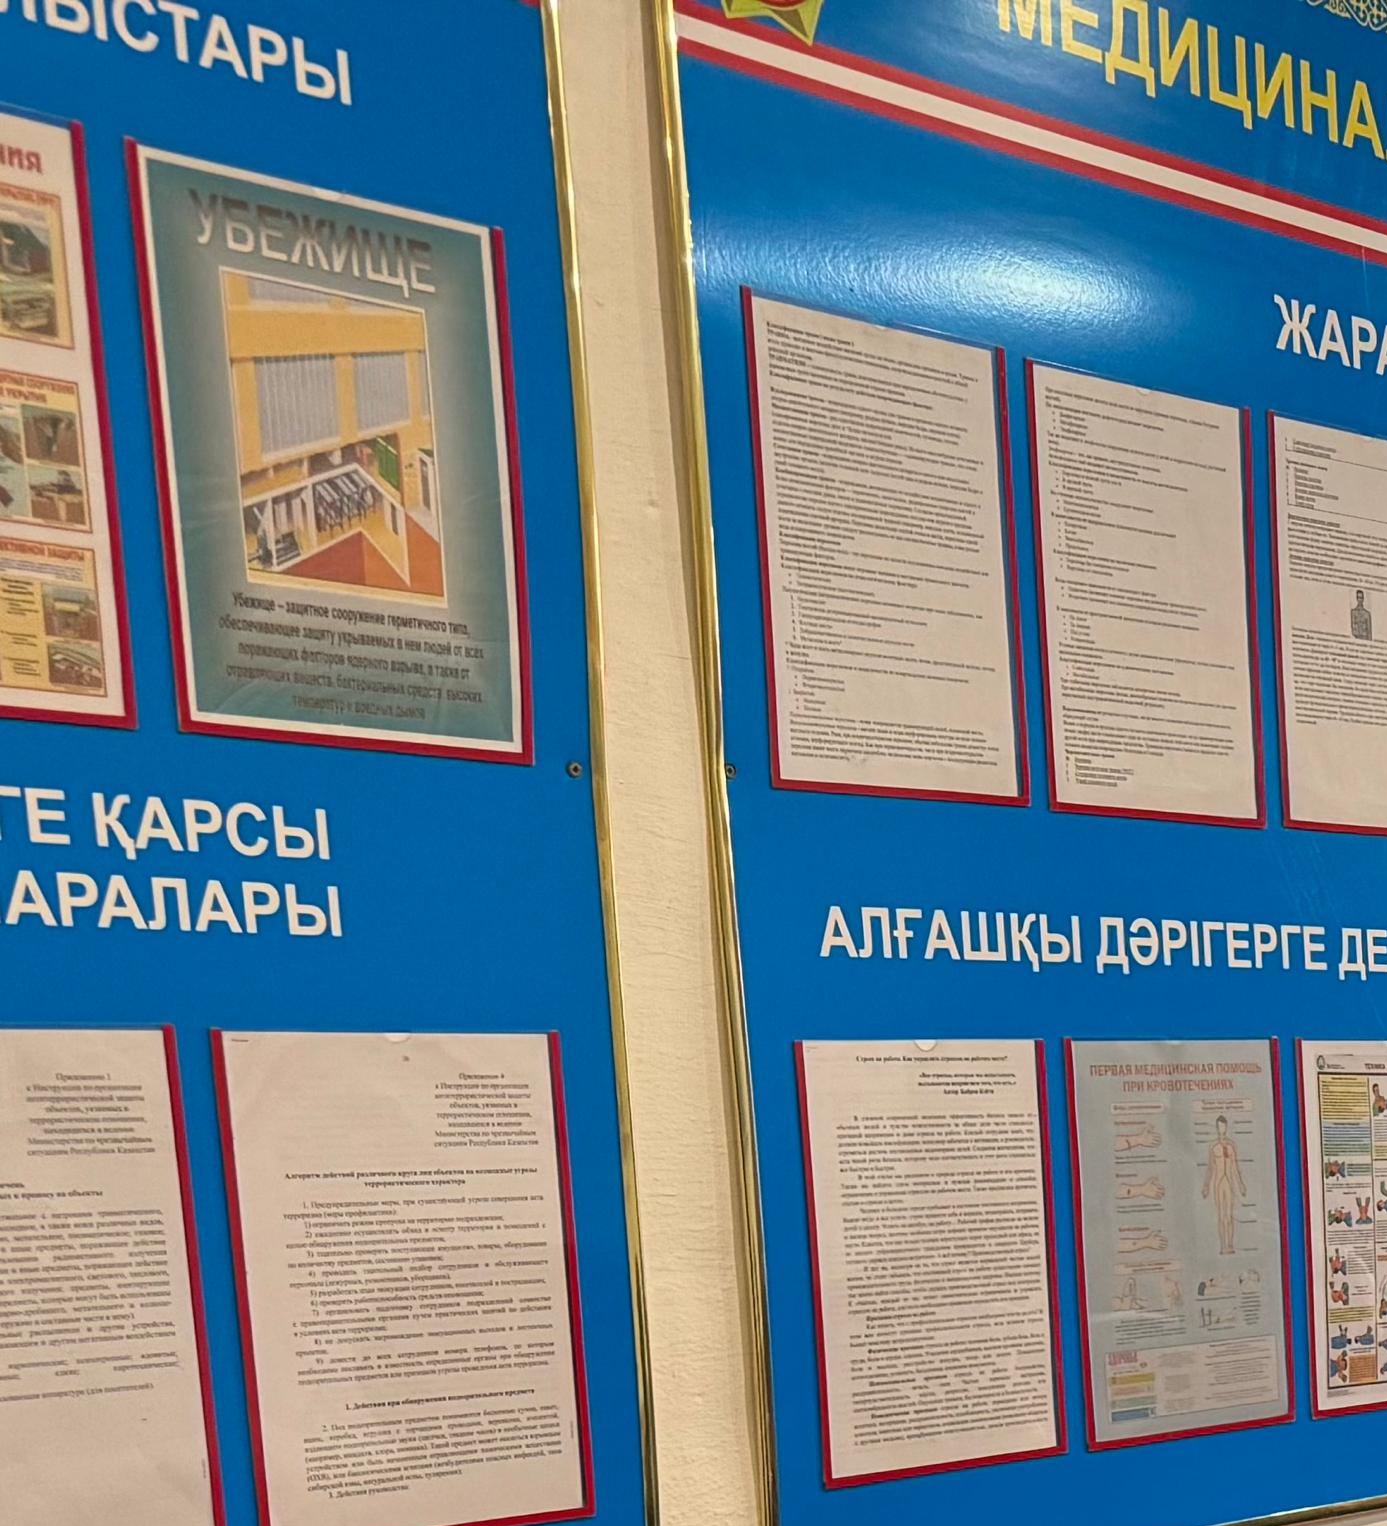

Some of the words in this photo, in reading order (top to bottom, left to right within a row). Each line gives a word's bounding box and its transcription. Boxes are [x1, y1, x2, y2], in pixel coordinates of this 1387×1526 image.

[188, 188, 436, 298] УБЕЖИЩЕ
[92, 792, 330, 860] ҚАРСЫ
[0, 870, 343, 937] АРАЛАРЫ
[820, 905, 1082, 973] АЛҒАШҚЫ
[1096, 916, 1328, 975] ДӘРІГЕРГЕ
[1089, 1064, 1133, 1077] ПЕРВАЯ
[1134, 1063, 1214, 1077] МЕДИЦИНСКАЯ
[1215, 1062, 1262, 1075] ПОМОЩЬ
[1122, 1080, 1144, 1092] ПРИ
[1146, 1079, 1234, 1092] КРОВОТЕЧЕНИЯХ
